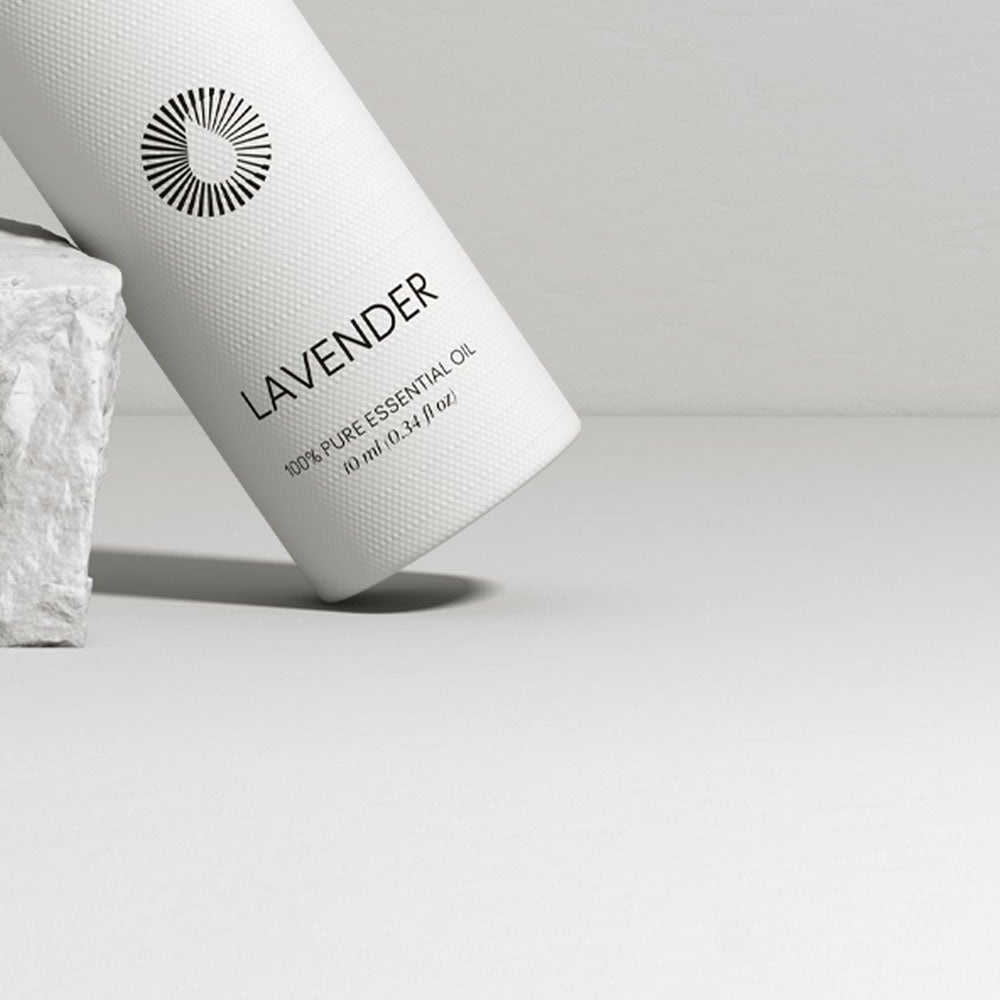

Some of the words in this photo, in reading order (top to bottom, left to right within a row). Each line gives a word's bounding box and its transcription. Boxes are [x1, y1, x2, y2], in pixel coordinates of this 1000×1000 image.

[240, 272, 439, 420] LAVENDER
[284, 448, 323, 478] 100%
[320, 419, 366, 457] PURE
[364, 361, 453, 429] ESSENTIAL
[449, 343, 476, 366] OIL
[343, 455, 361, 475] 10
[362, 439, 383, 465] ml
[384, 413, 422, 451] (0.34
[421, 402, 435, 427] fl
[435, 388, 458, 414] oz)
